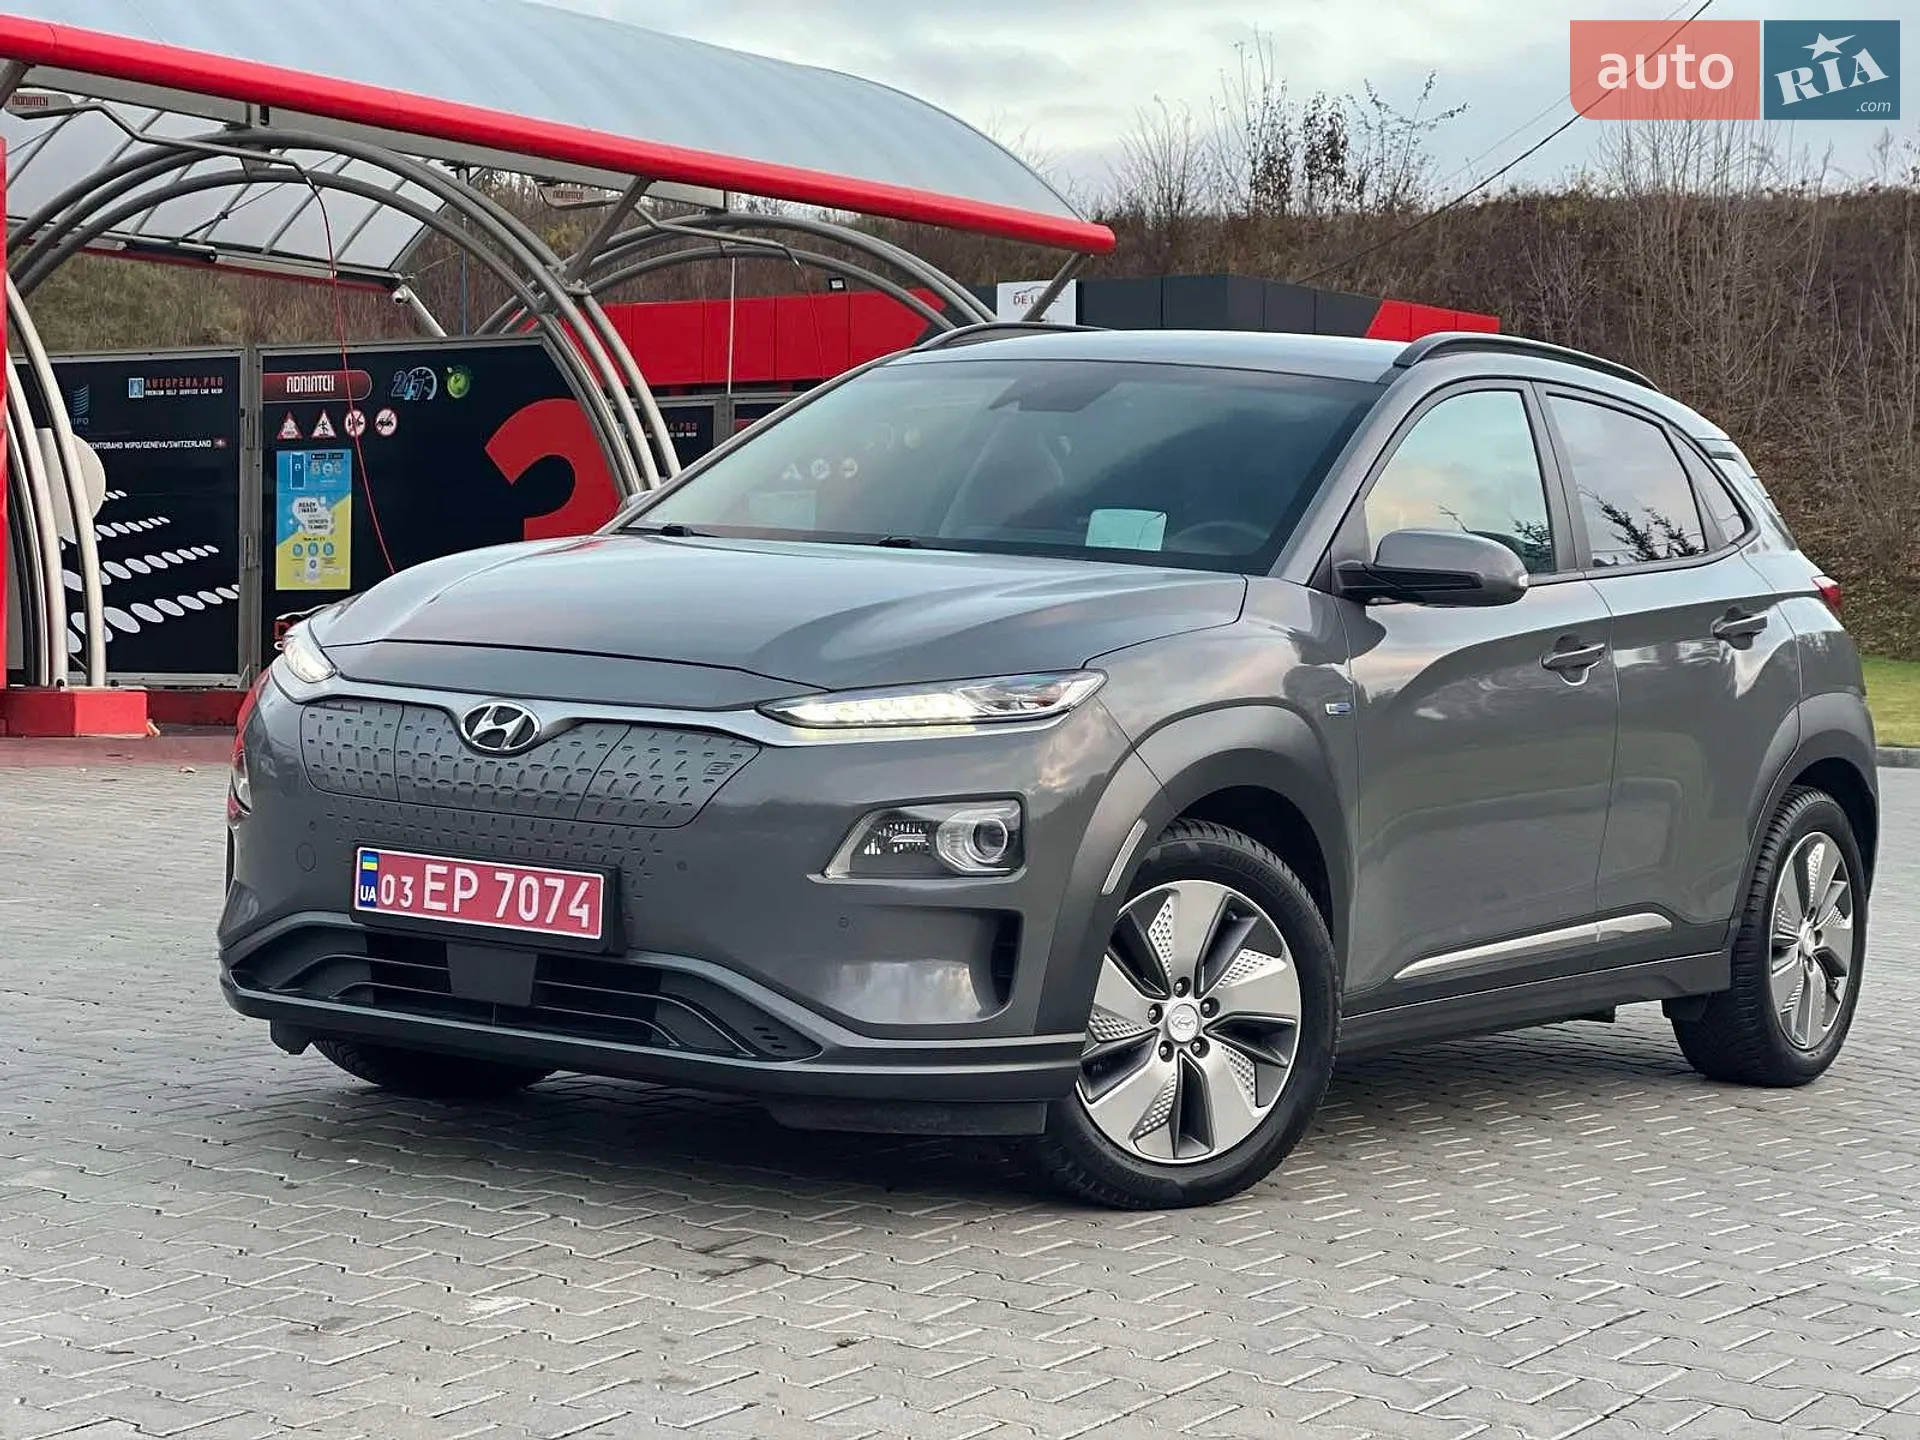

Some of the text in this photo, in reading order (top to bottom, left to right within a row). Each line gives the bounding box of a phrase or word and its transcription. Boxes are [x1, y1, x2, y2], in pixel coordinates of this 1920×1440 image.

[360, 885, 377, 902] UA
[380, 863, 590, 929] 03 EP 7074
